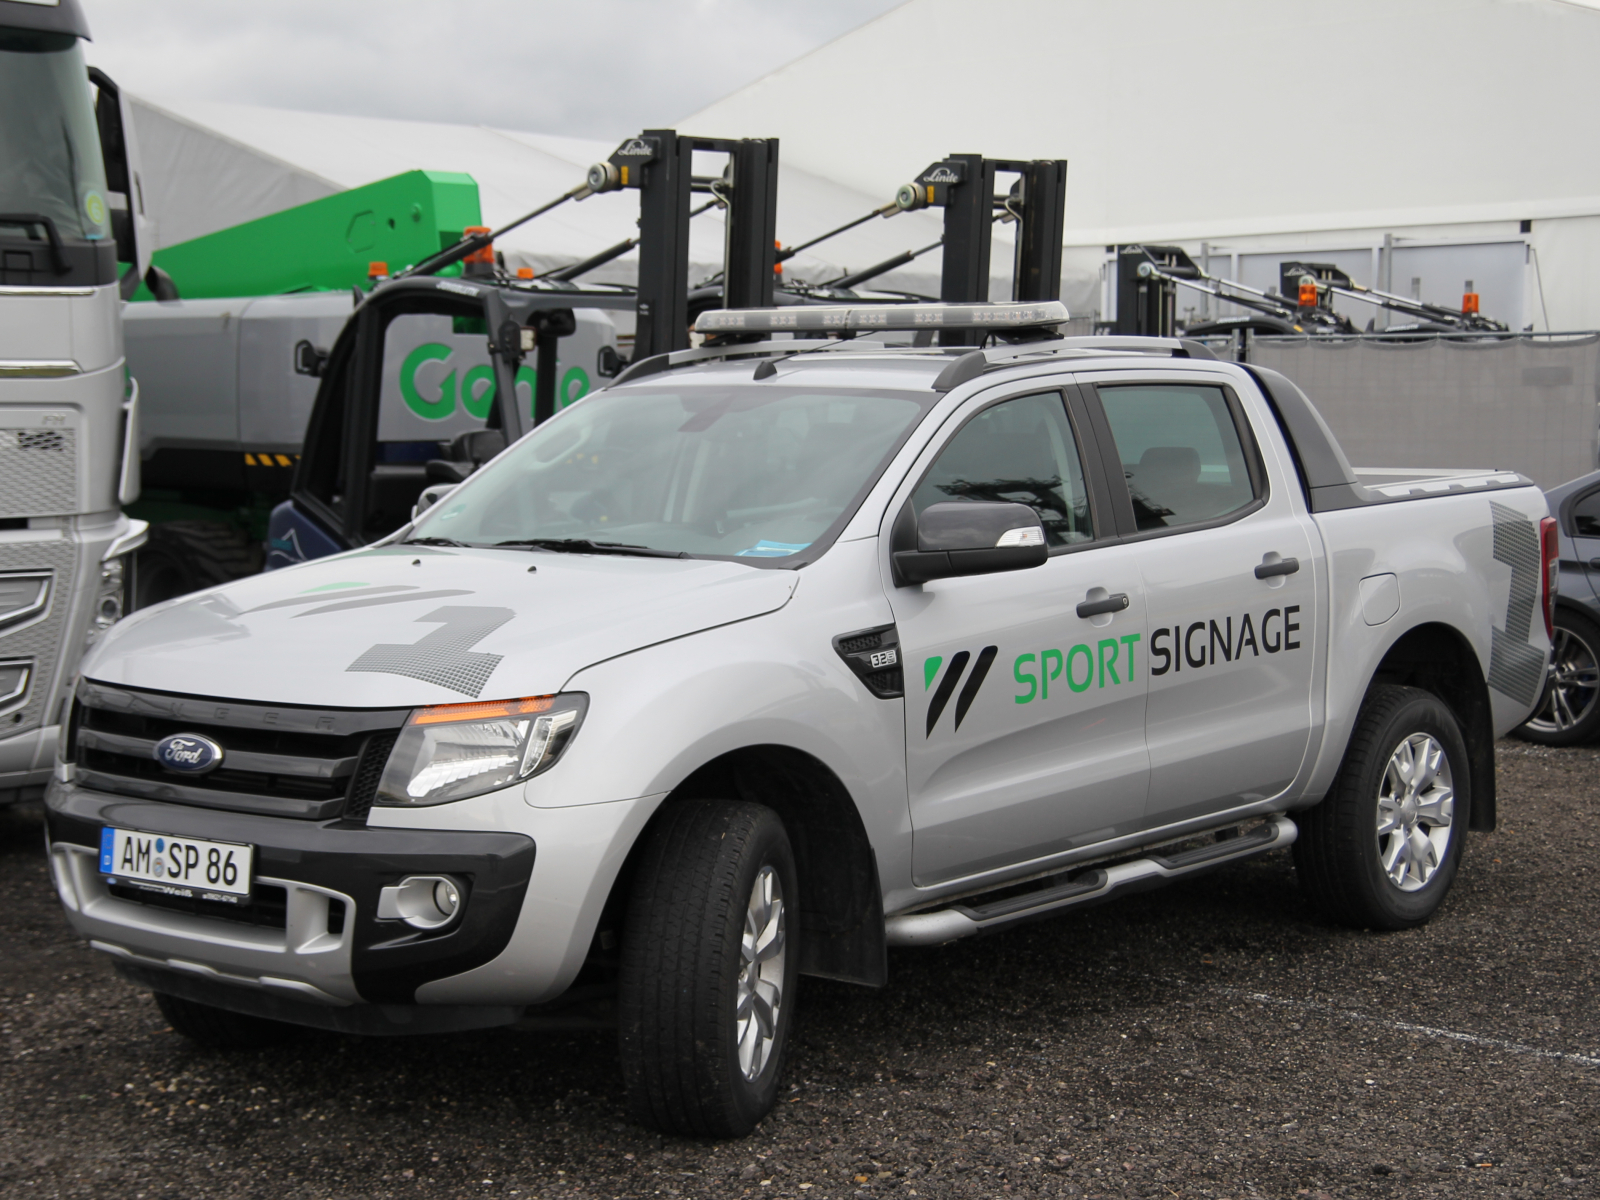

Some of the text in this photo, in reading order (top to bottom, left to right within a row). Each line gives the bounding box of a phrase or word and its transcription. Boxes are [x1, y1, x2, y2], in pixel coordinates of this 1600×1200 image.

[617, 139, 653, 156] Linde
[923, 167, 958, 183] Linde
[399, 342, 590, 420] Gene
[1013, 604, 1301, 705] SPORT SIGNAGE
[165, 738, 204, 764] Ford
[121, 836, 238, 886] AM SP 86
